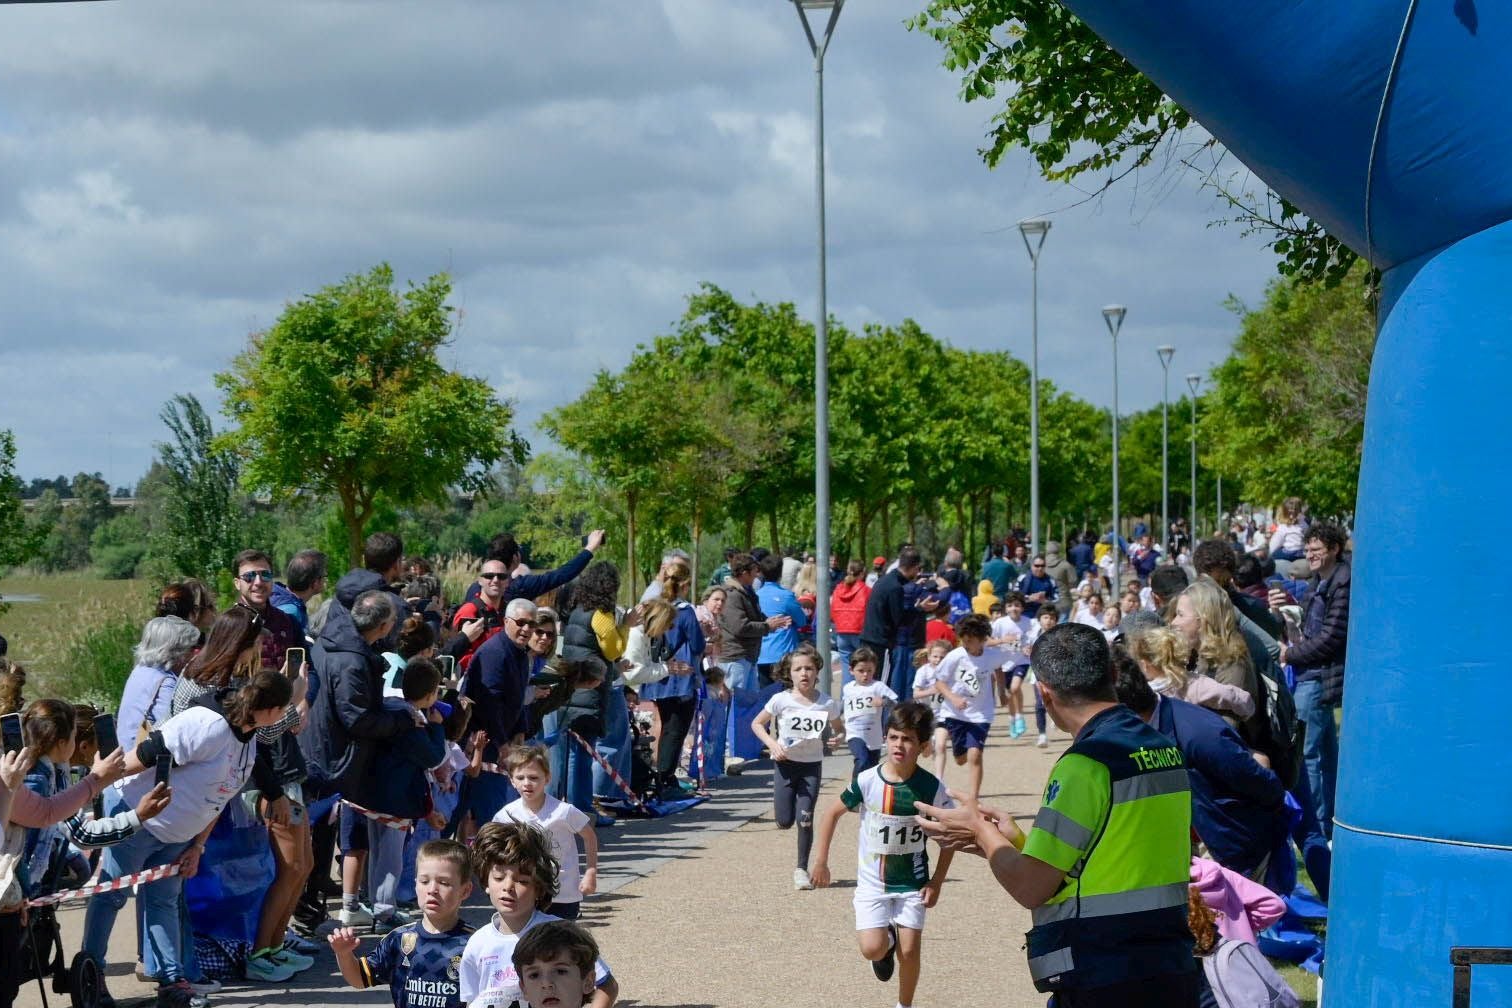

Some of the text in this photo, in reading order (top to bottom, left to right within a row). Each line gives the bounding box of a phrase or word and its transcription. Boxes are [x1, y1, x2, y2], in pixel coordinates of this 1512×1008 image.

[791, 716, 824, 732] 230
[1129, 746, 1183, 771] TÉCNICO
[879, 825, 923, 845] 115
[418, 994, 447, 1008] BETTER
